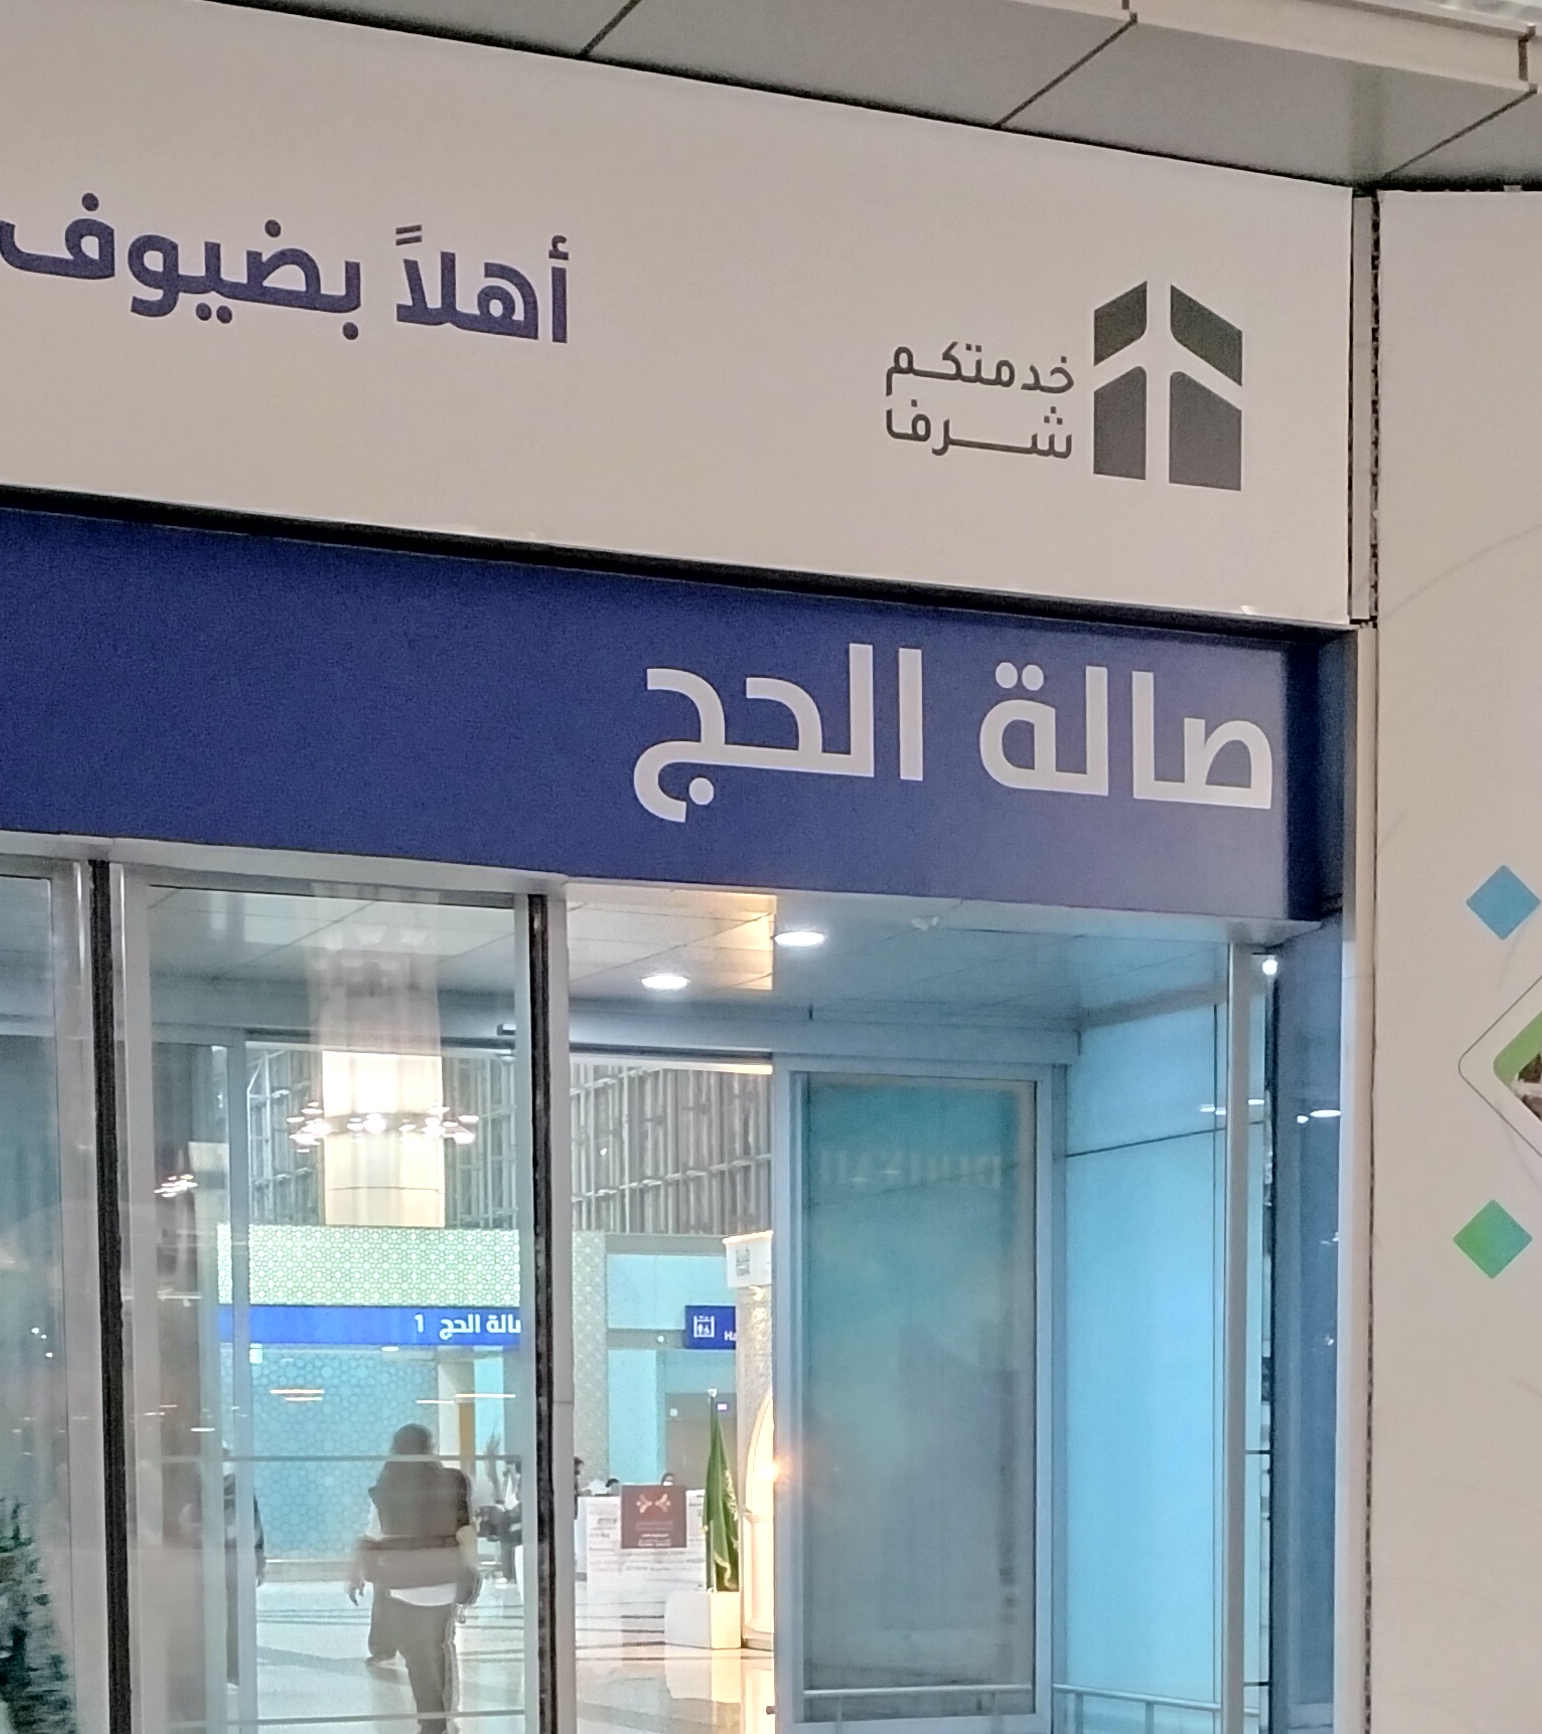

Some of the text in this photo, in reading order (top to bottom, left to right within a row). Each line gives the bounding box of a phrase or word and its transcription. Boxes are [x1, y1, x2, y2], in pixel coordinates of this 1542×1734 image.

[886, 341, 1075, 397] خدمتكم
[633, 643, 1274, 823] صالة الحج
[414, 1313, 521, 1340] الة الحج 1
